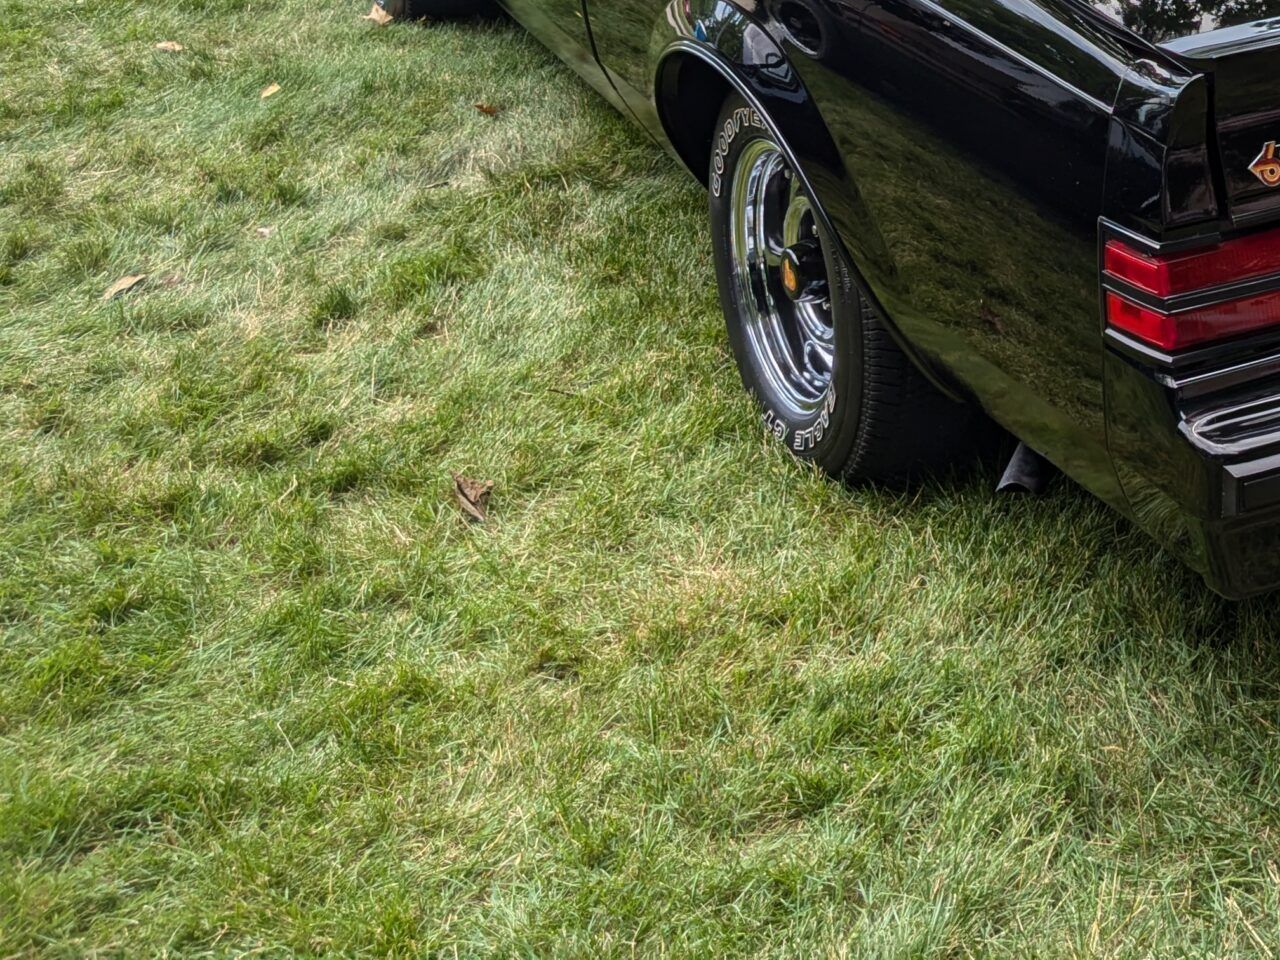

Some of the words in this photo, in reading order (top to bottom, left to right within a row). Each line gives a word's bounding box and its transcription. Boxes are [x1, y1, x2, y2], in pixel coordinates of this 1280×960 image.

[711, 107, 767, 197] GOODYE
[761, 409, 786, 441] GT
[793, 380, 837, 451] EAGLE
